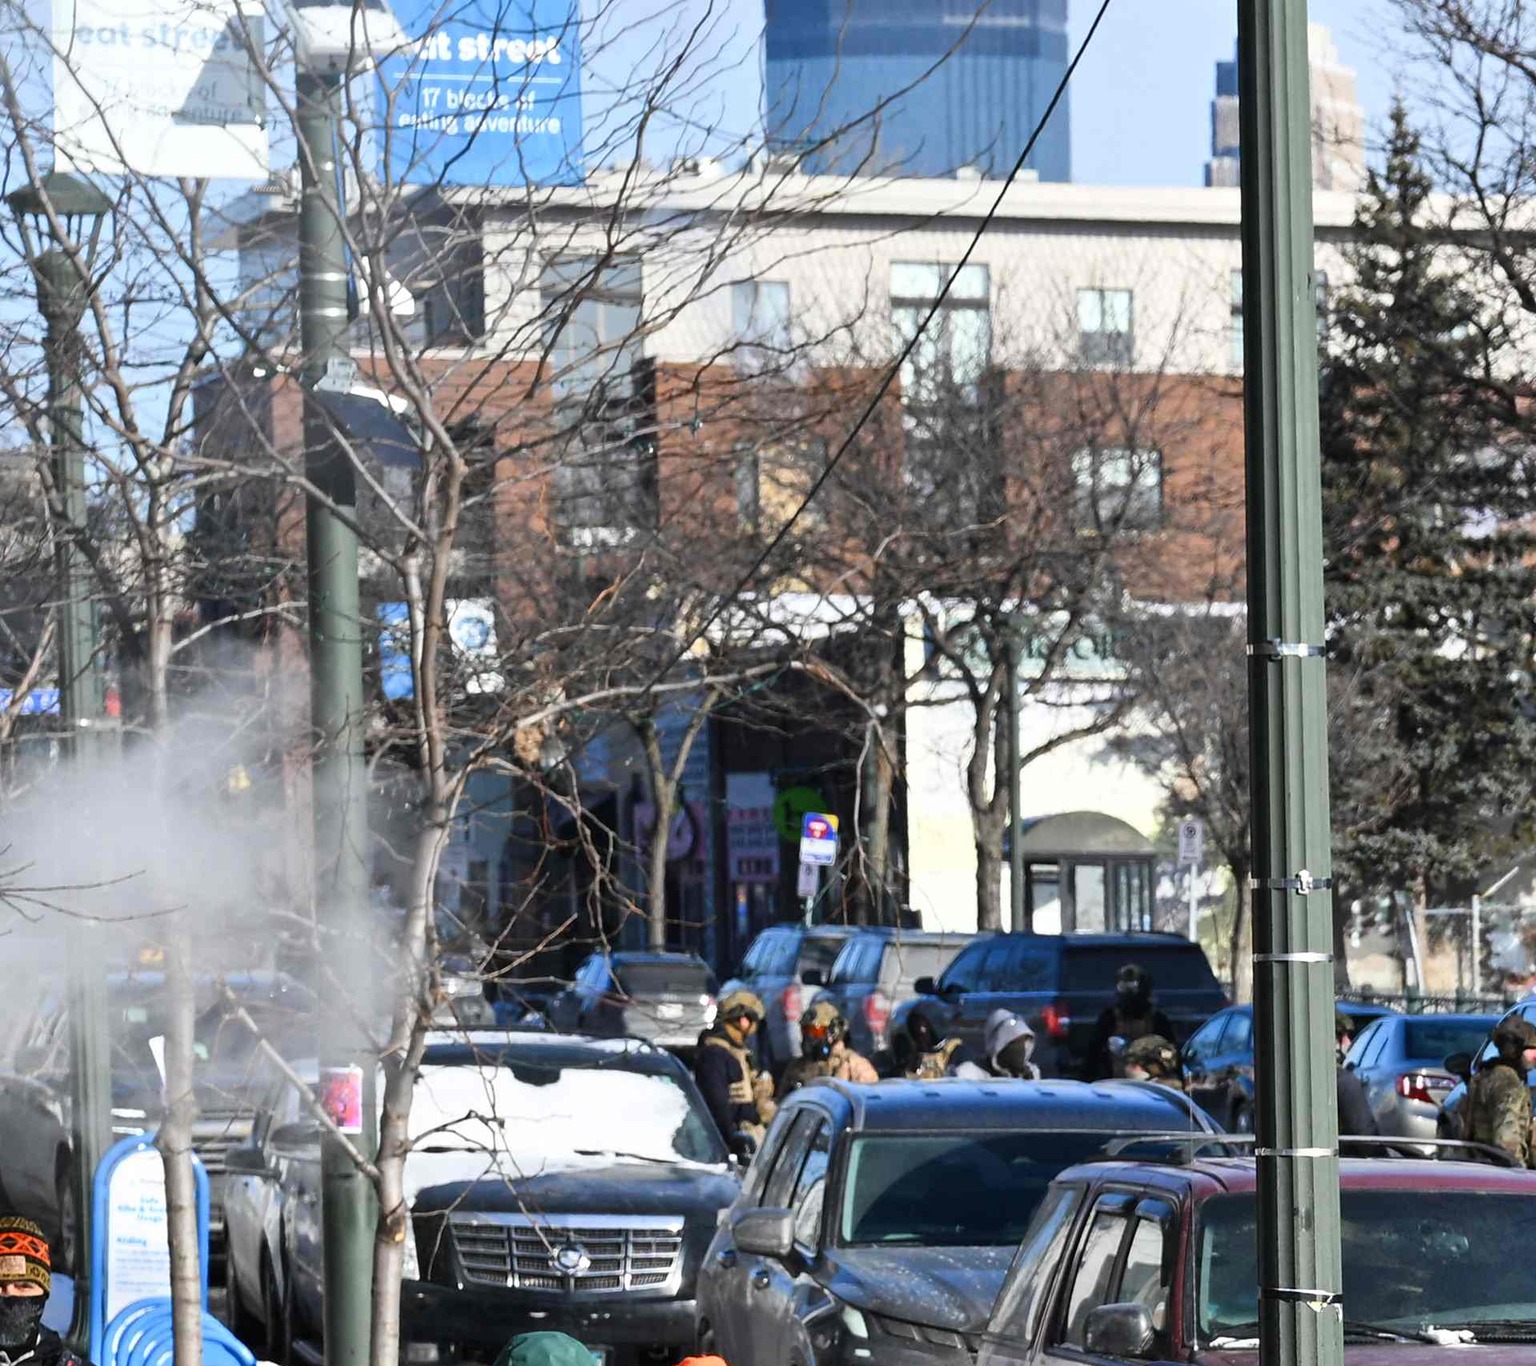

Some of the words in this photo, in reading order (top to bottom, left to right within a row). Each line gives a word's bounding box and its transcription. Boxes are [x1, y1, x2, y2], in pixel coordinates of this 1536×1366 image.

[458, 35, 562, 64] street
[422, 87, 438, 107] 17
[447, 87, 500, 109] blocks
[399, 111, 459, 135] eating
[464, 110, 562, 135] adventure
